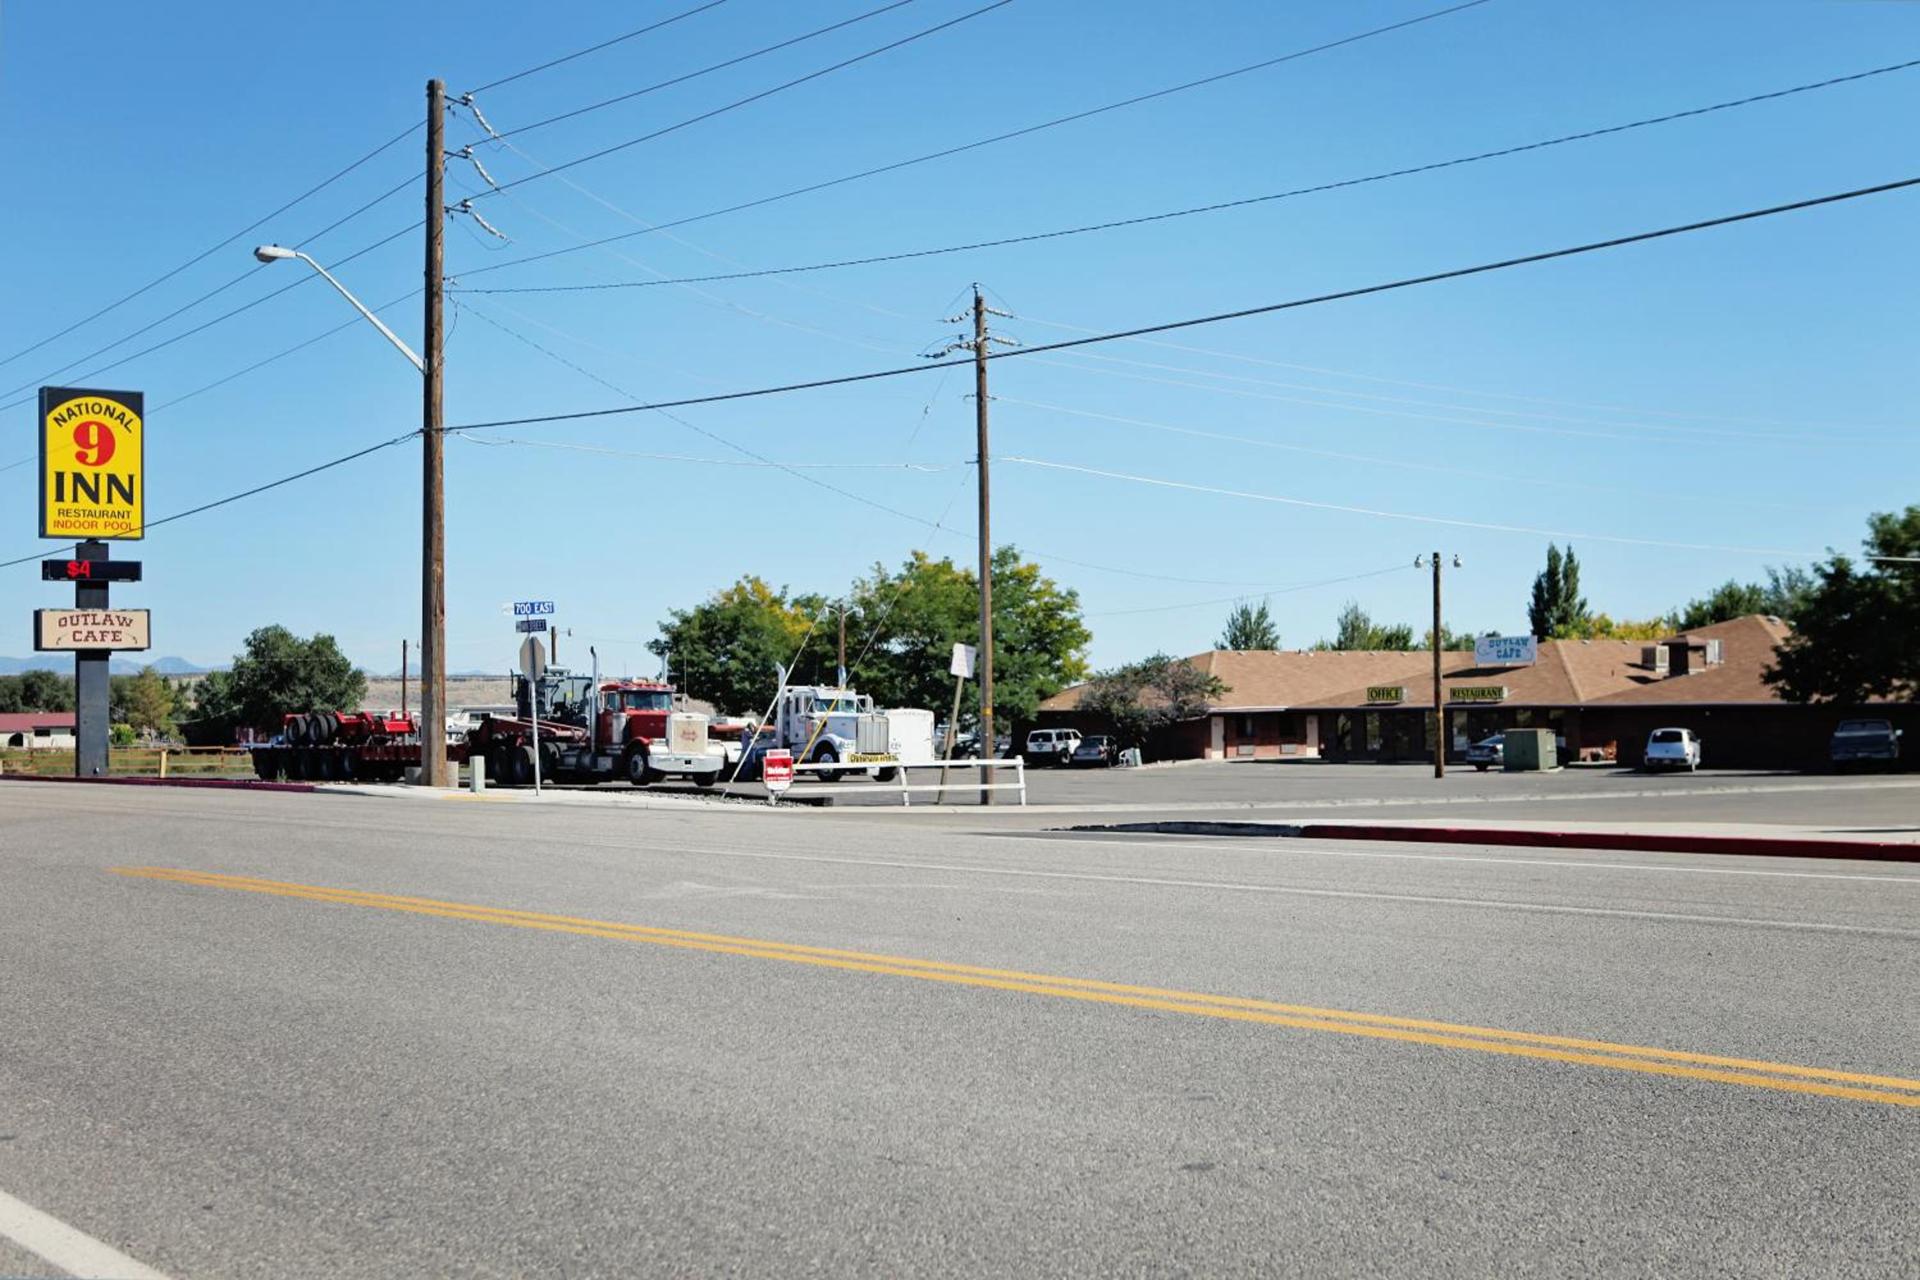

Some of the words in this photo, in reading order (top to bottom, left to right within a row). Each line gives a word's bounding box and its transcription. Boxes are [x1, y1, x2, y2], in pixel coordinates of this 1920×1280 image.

[53, 402, 134, 434] NATIONAL
[73, 420, 116, 467] 9
[54, 471, 135, 506] INN
[57, 508, 132, 519] RESTAURANT
[53, 520, 98, 529] INDOOR
[104, 521, 135, 531] POOL
[516, 603, 531, 614] 700
[534, 602, 553, 613] EAST
[58, 613, 134, 627] OUTLAW
[72, 630, 122, 642] CAFE
[1496, 648, 1521, 659] CAFE
[1370, 689, 1400, 699] OFFICE
[1451, 688, 1502, 699] RESTAURANT
